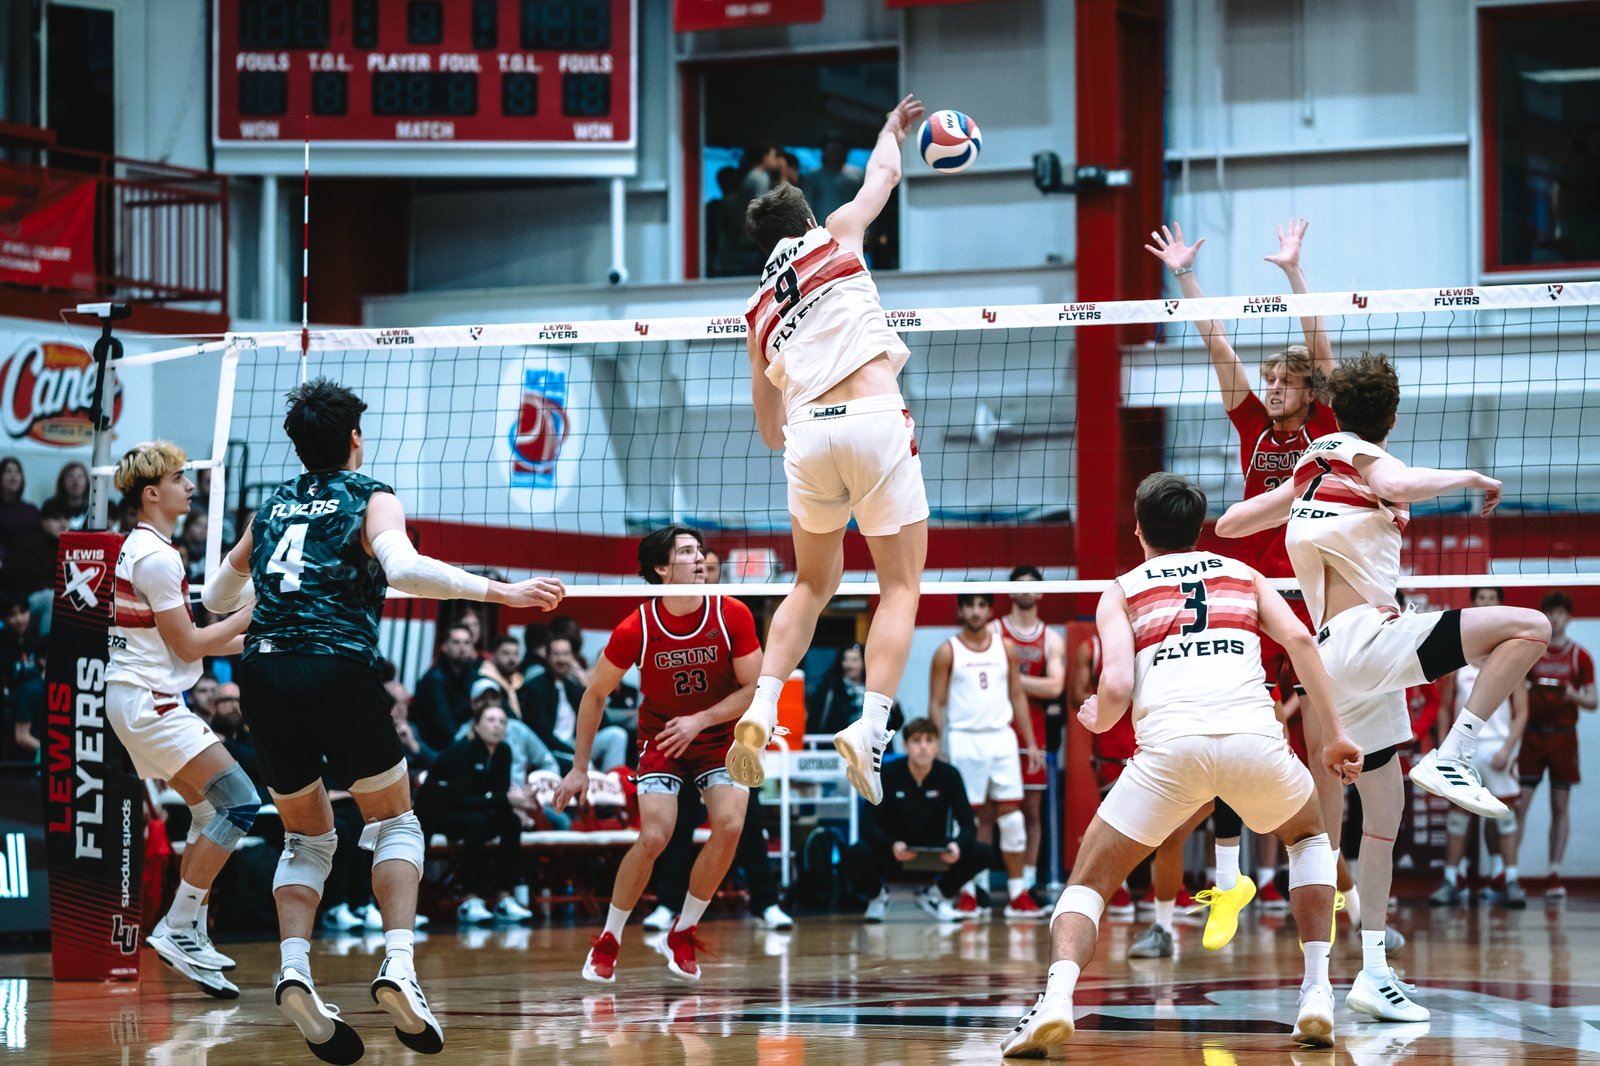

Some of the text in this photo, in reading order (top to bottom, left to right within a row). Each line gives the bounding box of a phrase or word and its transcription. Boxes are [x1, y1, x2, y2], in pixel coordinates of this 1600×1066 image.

[236, 53, 289, 71] FOULS
[367, 53, 431, 71] PLAYER
[440, 53, 482, 71] FOUL
[559, 53, 613, 71] FOULS
[240, 121, 613, 139] WON MATCH WON
[774, 265, 800, 319] 9
[1248, 296, 1282, 304] LEWIS
[1439, 288, 1474, 297] LEWIS
[1063, 303, 1096, 312] LEWIS
[1243, 303, 1288, 313] FLYERS
[1434, 296, 1480, 306] FLYERS
[710, 317, 742, 325] LEWIS
[884, 310, 917, 318] LEWIS
[1058, 311, 1101, 321] FLYERS
[706, 324, 747, 334] FLYERS
[886, 318, 922, 327] LYERS
[376, 336, 415, 345] FLYERS
[539, 330, 578, 339] FLYERS
[2, 338, 110, 433] Cane
[1303, 440, 1343, 455] EWIS
[269, 499, 340, 520] FLYERS
[65, 549, 104, 561] LEWIS
[266, 523, 310, 594] 4
[1145, 558, 1223, 580] LEWIS
[1180, 579, 1208, 637] 3
[654, 646, 718, 670] CSUN
[1152, 639, 1245, 666] FLYERS
[673, 669, 708, 696] 23
[48, 682, 72, 832] LEWIS
[75, 656, 105, 860] FLYERS
[121, 799, 131, 907] sports imports
